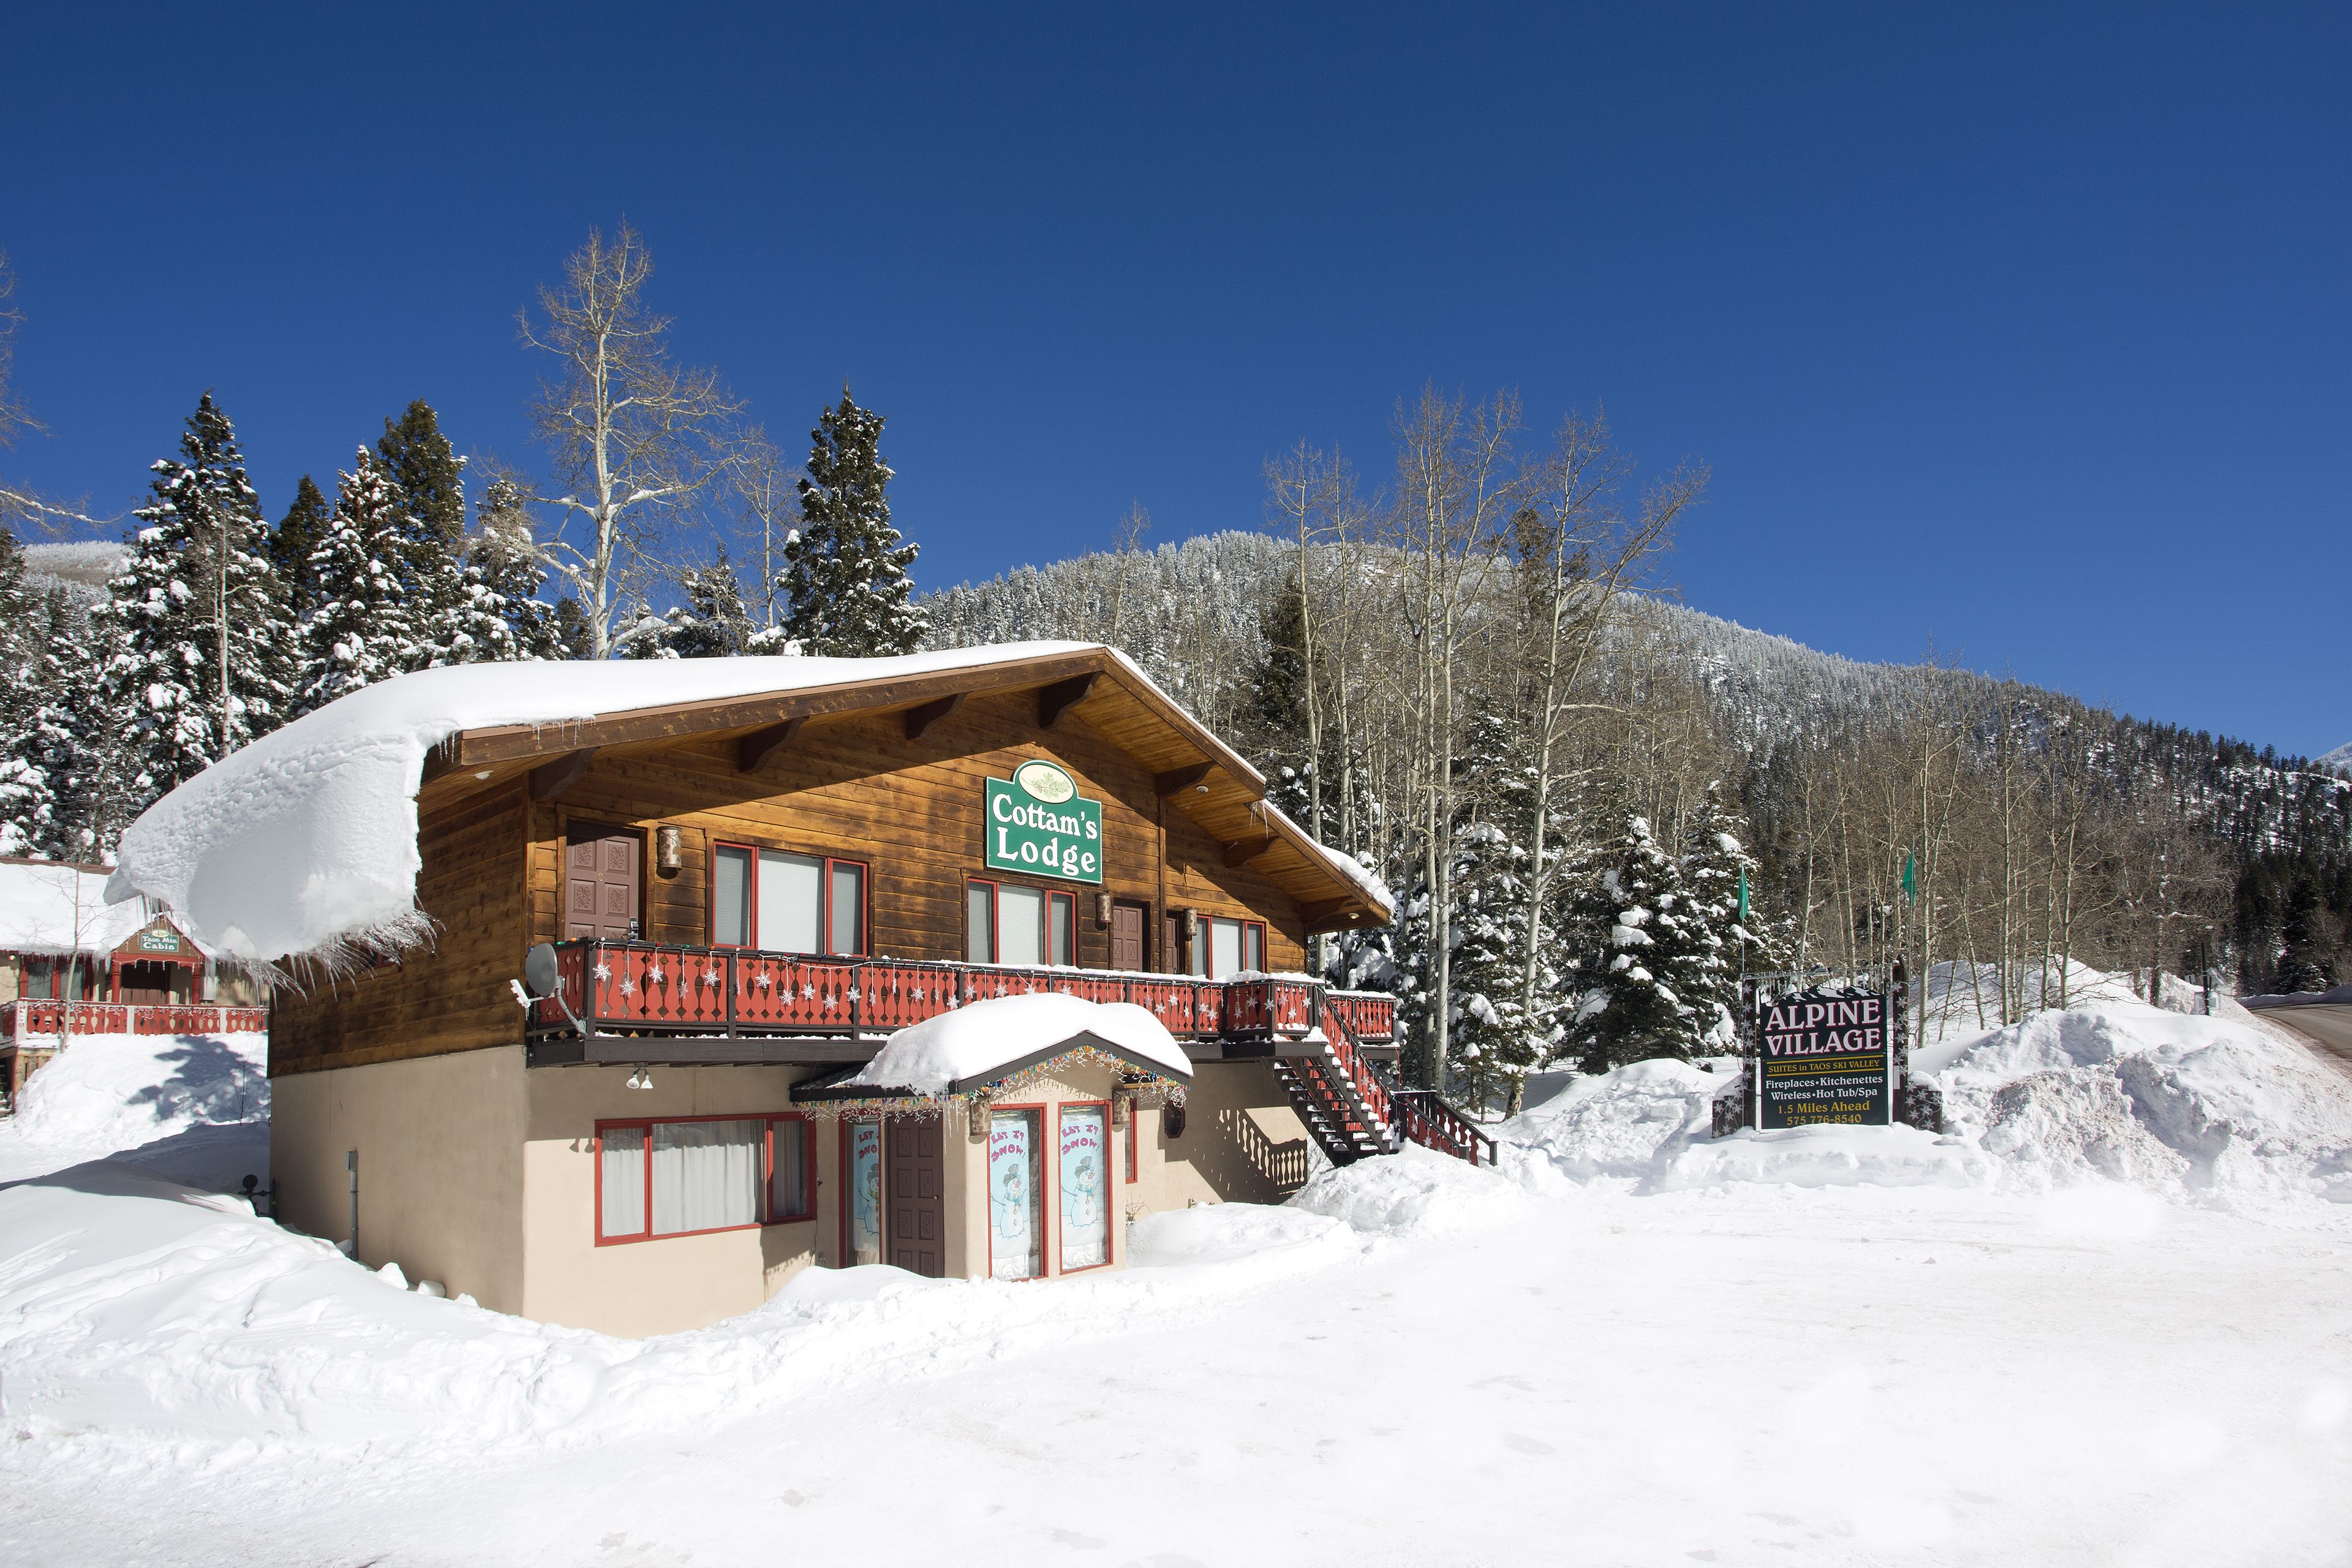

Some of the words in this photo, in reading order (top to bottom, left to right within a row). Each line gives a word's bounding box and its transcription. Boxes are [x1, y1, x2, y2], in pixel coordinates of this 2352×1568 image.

[992, 793, 1098, 840] Cottam's
[997, 826, 1096, 876] Lodge
[1765, 998, 1881, 1031] ALPINE
[1765, 1028, 1882, 1056] VILLAGE
[1768, 1065, 1797, 1073] SUITES
[1809, 1062, 1831, 1071] TAOS
[1849, 1060, 1880, 1068] VALLEY
[1766, 1079, 1815, 1090] Fireplaces
[1820, 1076, 1883, 1087] Kitchenettes
[1771, 1091, 1811, 1101] Wireless
[1816, 1089, 1834, 1098] Hot
[1837, 1087, 1878, 1098] Tub/Spa
[1778, 1104, 1793, 1114] 1.5
[1797, 1102, 1828, 1114] Miles
[1831, 1100, 1870, 1112] Ahead
[1787, 1116, 1806, 1126] 575
[1811, 1114, 1862, 1124] 776-8540
[858, 1131, 874, 1143] LET
[990, 1131, 1009, 1144] LET
[1012, 1130, 1025, 1142] IT
[1061, 1125, 1081, 1138] LET
[1085, 1124, 1098, 1135] IT
[858, 1144, 878, 1160] SNO
[1061, 1137, 1100, 1155] SNOW!
[990, 1144, 1026, 1163] SNOW!
